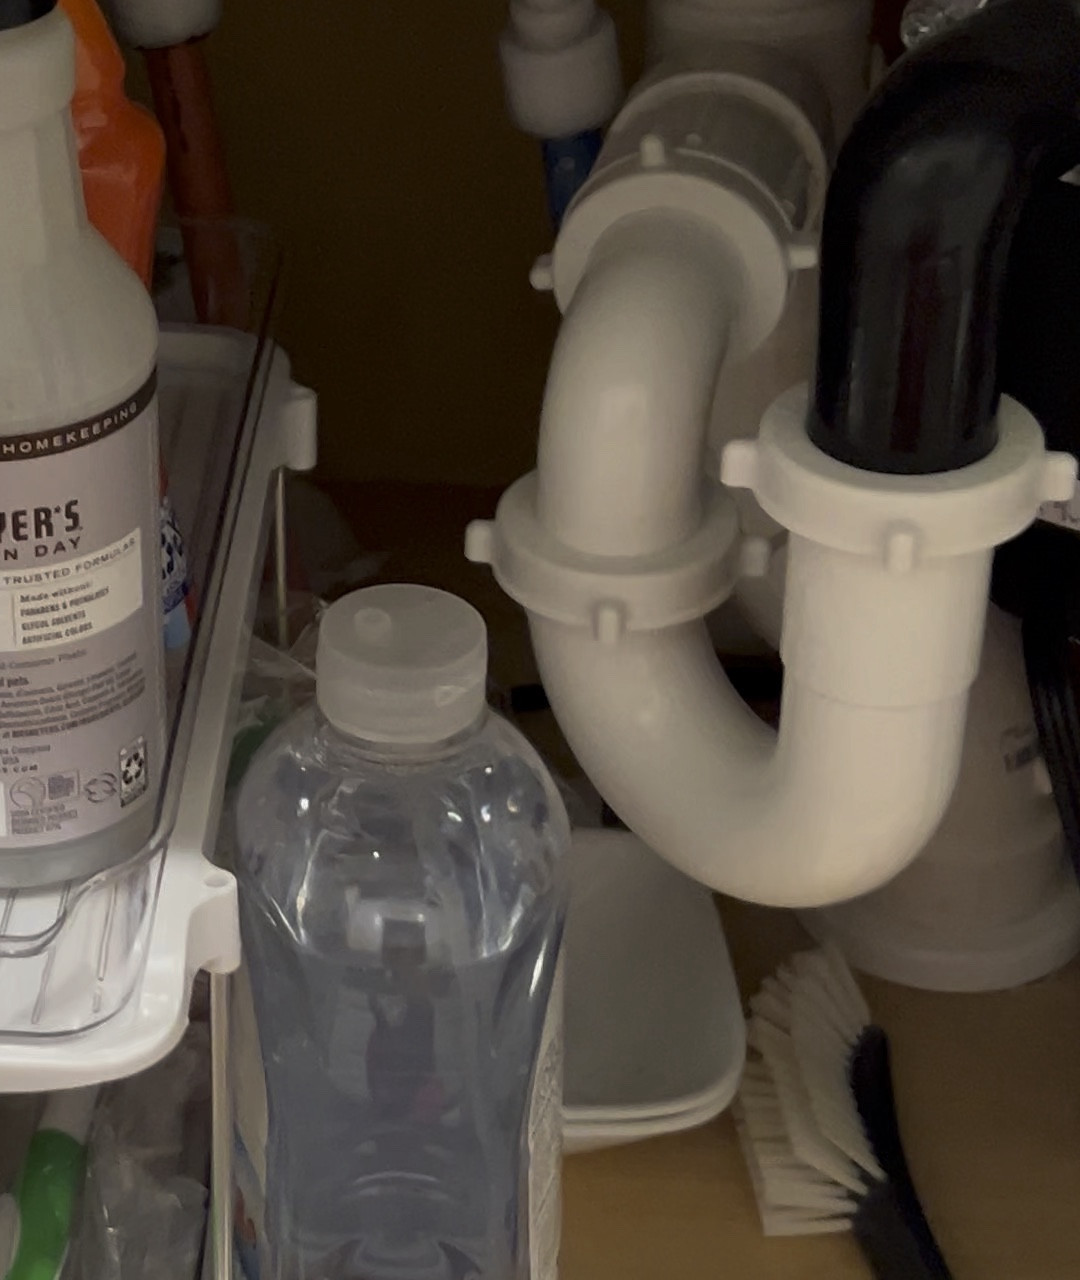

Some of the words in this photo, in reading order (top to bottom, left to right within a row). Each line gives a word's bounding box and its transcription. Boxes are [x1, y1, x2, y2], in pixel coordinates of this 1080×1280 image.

[2, 400, 138, 455] HOMEKEEPING
[3, 566, 72, 586] TRUSTED
[74, 536, 137, 573] FORMULAS
[33, 535, 83, 558] DAY
